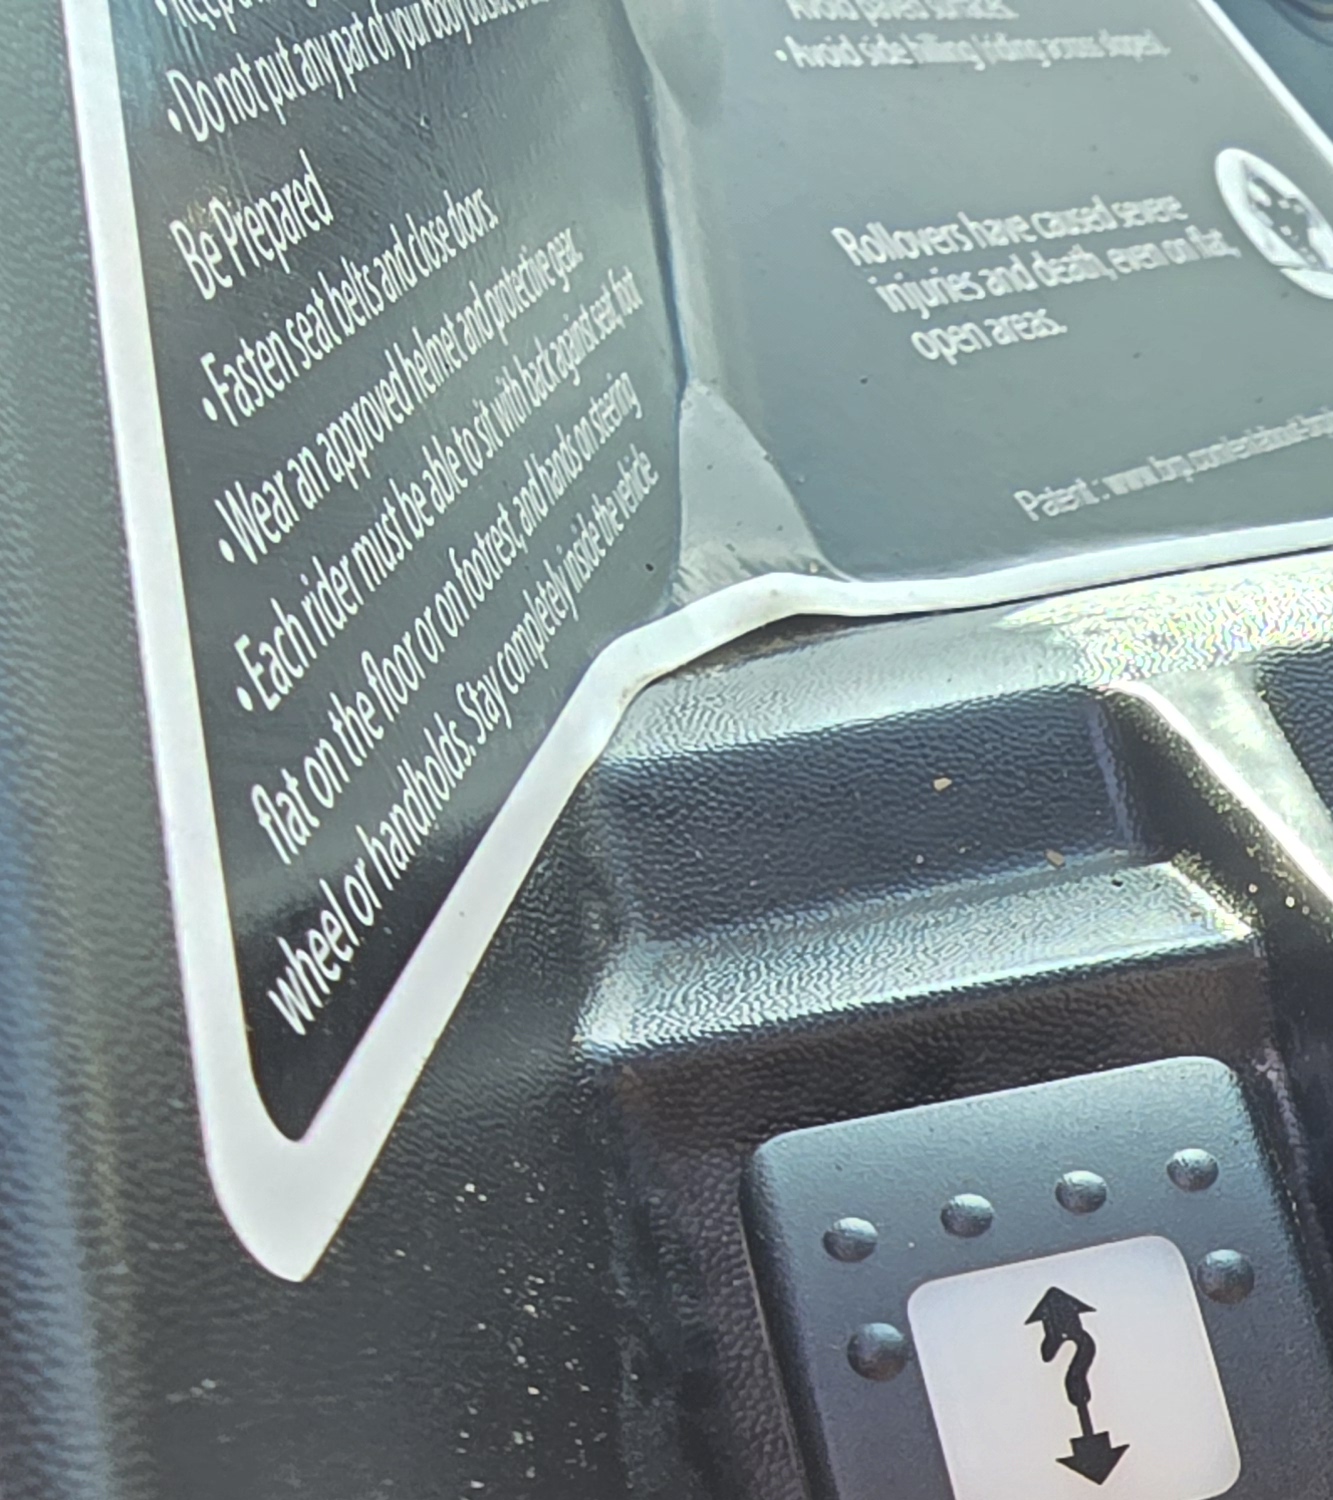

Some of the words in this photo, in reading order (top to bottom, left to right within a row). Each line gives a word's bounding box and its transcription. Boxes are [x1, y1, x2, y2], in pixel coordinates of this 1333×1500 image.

[167, 69, 225, 141] Do
[214, 53, 269, 124] not
[254, 37, 305, 125] put
[293, 32, 343, 99] any
[330, 13, 378, 92] part
[368, 0, 395, 61] of
[385, 3, 431, 69] your
[170, 220, 233, 300] Be
[209, 148, 333, 277] Prepared
[832, 221, 974, 266] Rollovers
[957, 211, 1038, 249] have
[1030, 194, 1119, 240] caused
[1111, 195, 1189, 229] severe
[201, 337, 298, 427] Fasten
[286, 287, 341, 369] seat
[318, 256, 384, 336] belts
[373, 224, 417, 302] and
[405, 213, 456, 277] close
[443, 188, 499, 248] doors.
[867, 267, 987, 320] injuries
[978, 253, 1039, 296] and
[911, 321, 992, 366] open
[984, 308, 1069, 346] areas.
[215, 481, 300, 564] Wear
[288, 446, 330, 509] an
[316, 349, 414, 489] approved
[393, 313, 468, 403] helmet
[456, 281, 494, 354] and
[484, 245, 556, 345] protective
[565, 416, 600, 462] on
[588, 371, 643, 445] steering
[512, 458, 557, 537] and
[530, 423, 583, 504] hands
[234, 597, 317, 711] Each
[300, 555, 363, 646] rider
[351, 497, 412, 592] must
[389, 478, 434, 539] be
[422, 435, 468, 514] able
[451, 426, 483, 476] to
[472, 399, 503, 459] sit
[491, 366, 533, 437] with
[513, 335, 561, 407] back
[550, 305, 599, 387] against
[591, 493, 624, 547] the
[448, 502, 528, 611] footrest,
[556, 512, 607, 594] inside
[414, 605, 446, 664] or
[434, 580, 470, 638] on
[497, 558, 580, 695] completely
[360, 631, 426, 724] floor
[454, 665, 512, 745] Stay
[327, 692, 384, 767] the
[303, 737, 350, 809] on
[354, 712, 477, 891] handholds.
[251, 768, 320, 865] flat
[344, 857, 383, 928] or
[267, 878, 360, 1036] wheel
